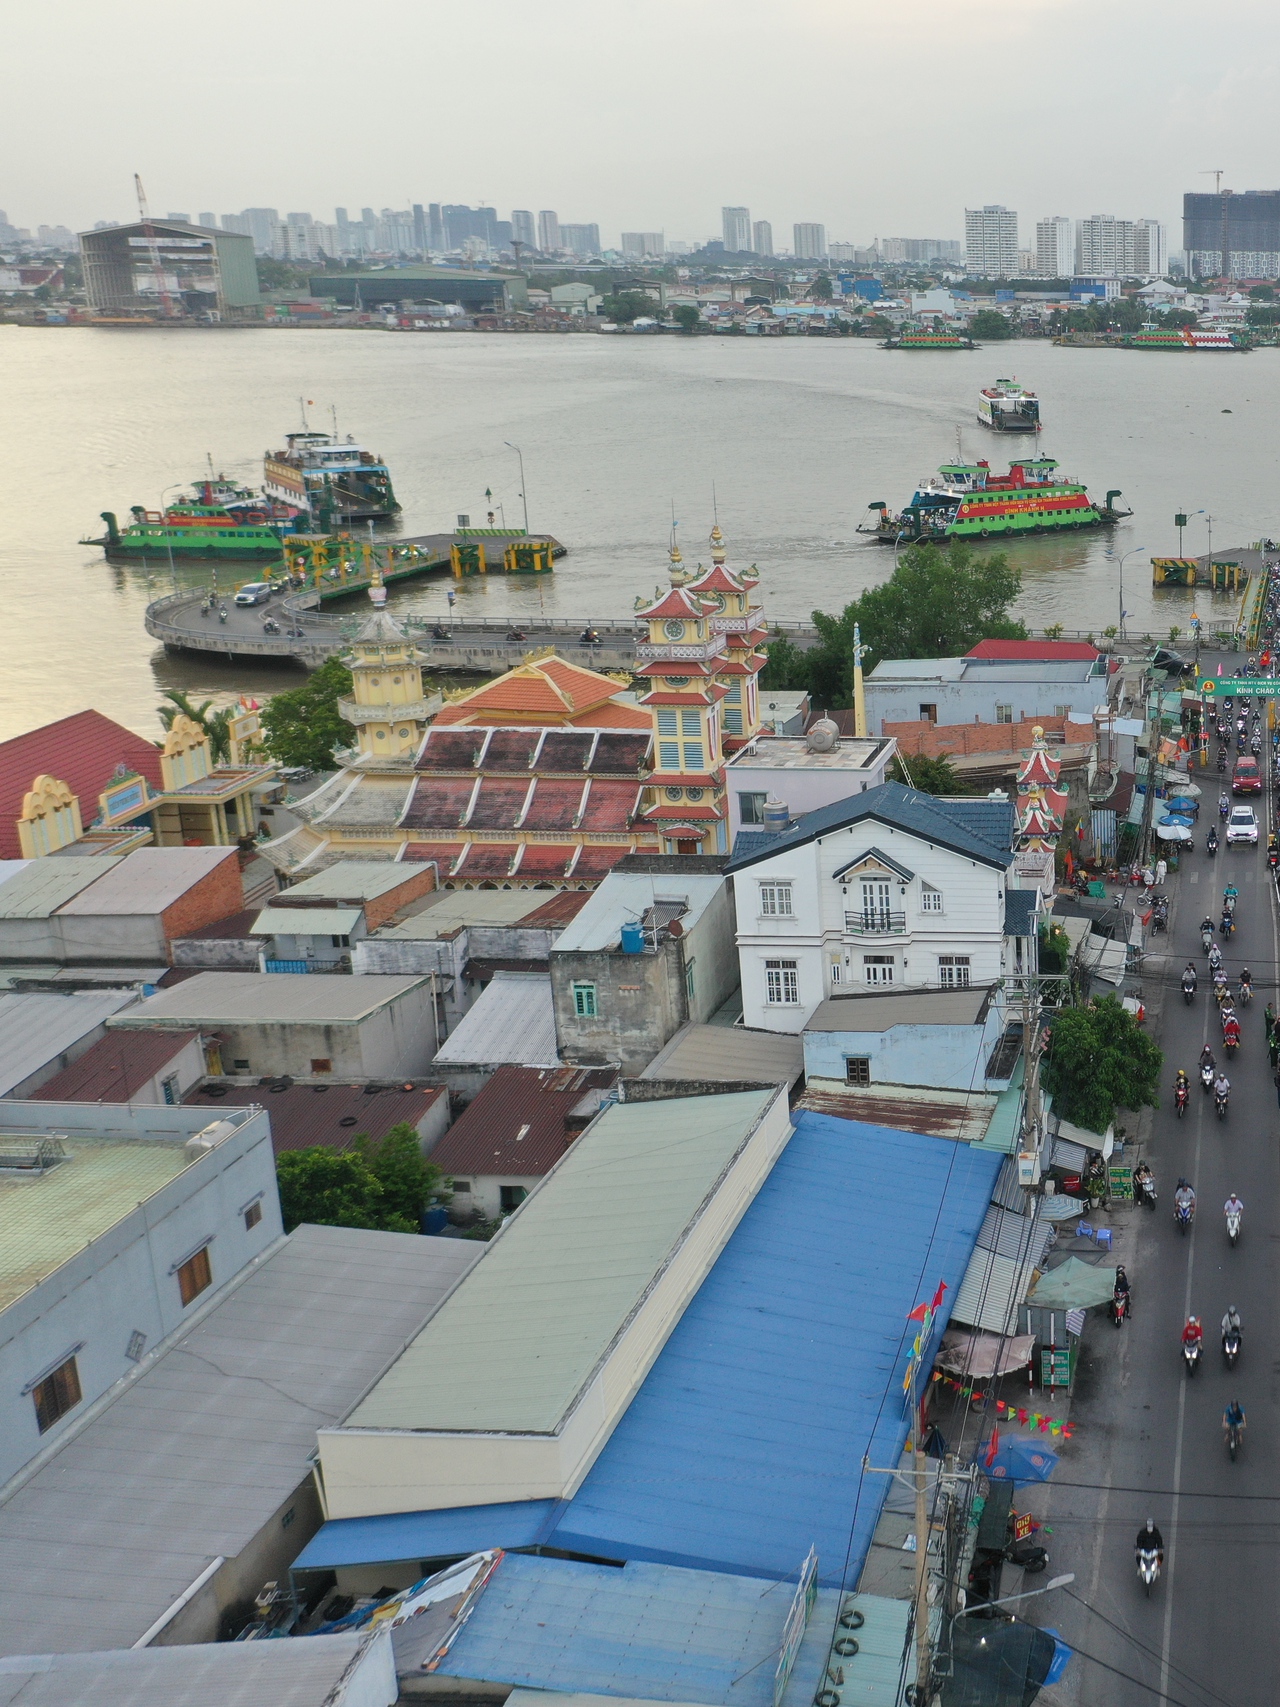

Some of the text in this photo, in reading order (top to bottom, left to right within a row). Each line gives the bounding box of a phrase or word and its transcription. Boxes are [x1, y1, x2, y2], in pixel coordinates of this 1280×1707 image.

[1236, 686, 1253, 694] KÍNH
[1255, 686, 1275, 694] CHÀO
[1020, 1526, 1029, 1537] XE
